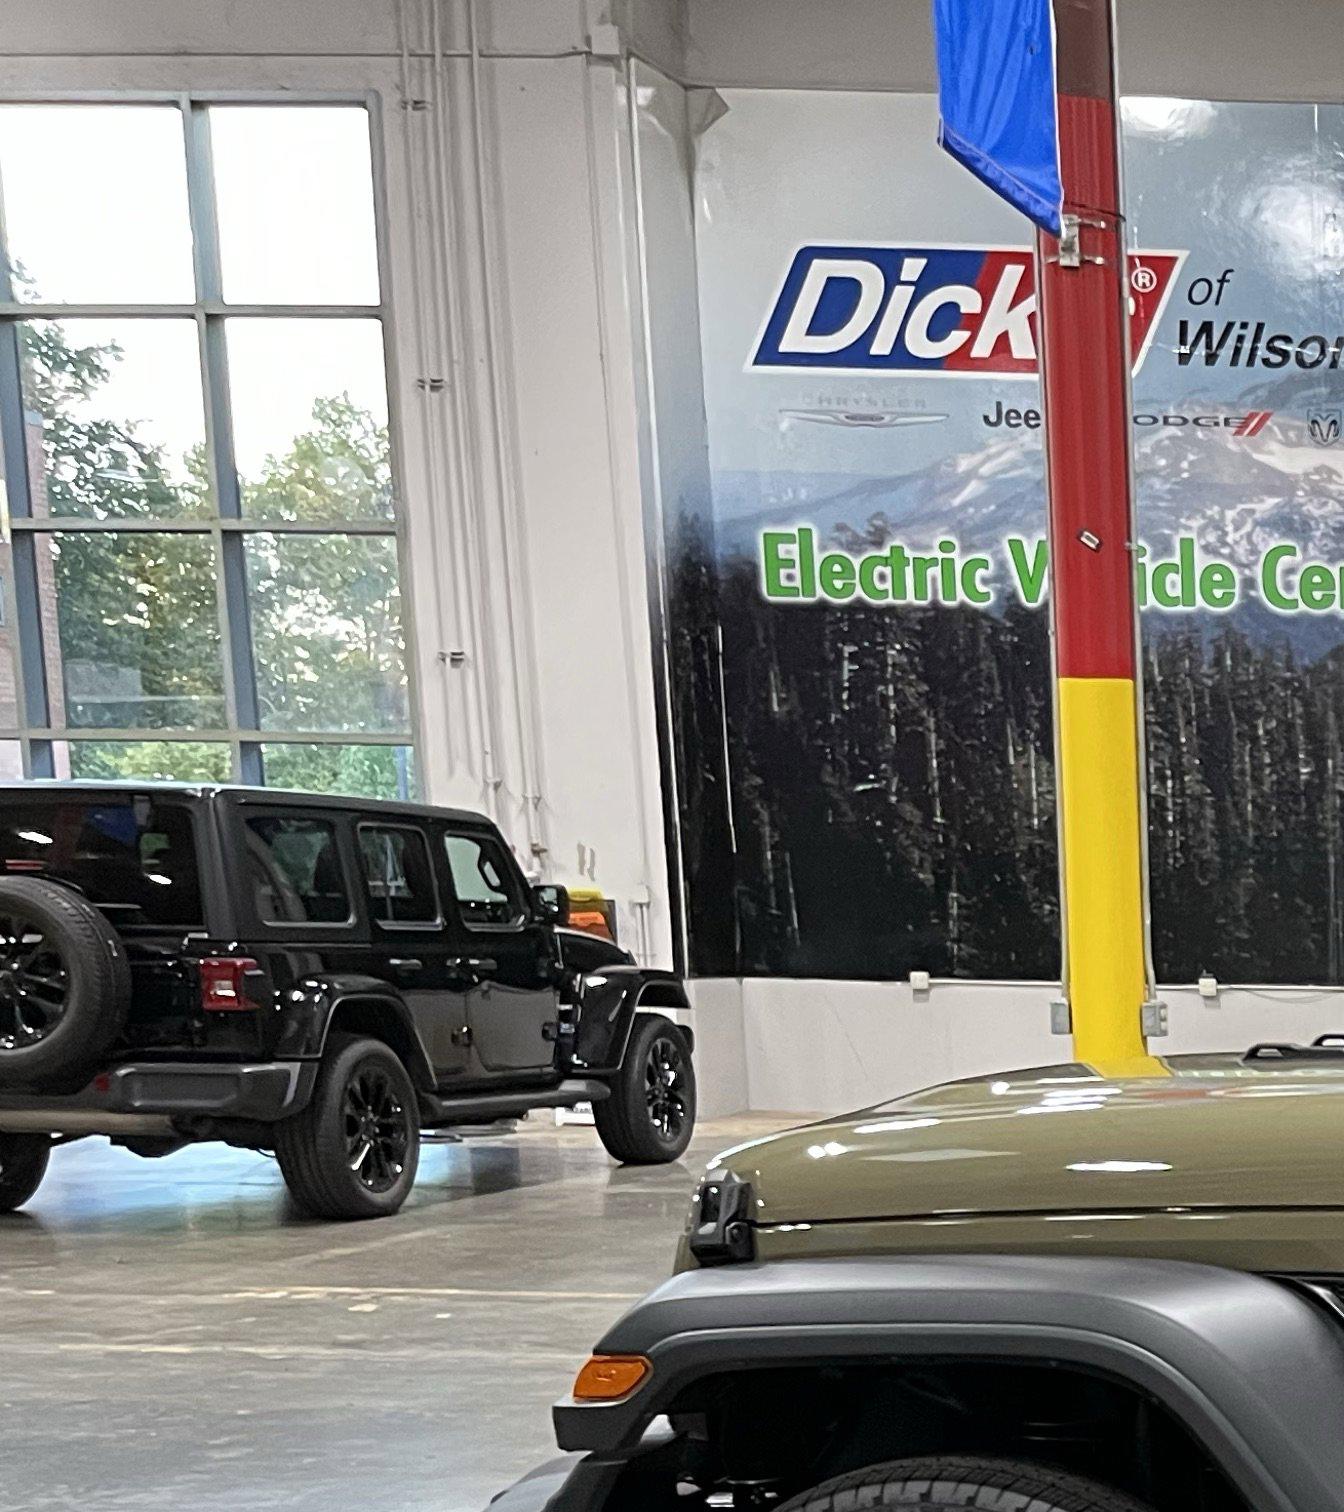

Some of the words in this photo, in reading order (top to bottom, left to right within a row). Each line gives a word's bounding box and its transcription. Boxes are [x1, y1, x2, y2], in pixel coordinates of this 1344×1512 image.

[1187, 268, 1235, 306] of
[983, 401, 1040, 428] Jee
[1133, 413, 1248, 428] ODGE
[763, 528, 991, 603] Electric
[1008, 536, 1236, 608] Vicle
